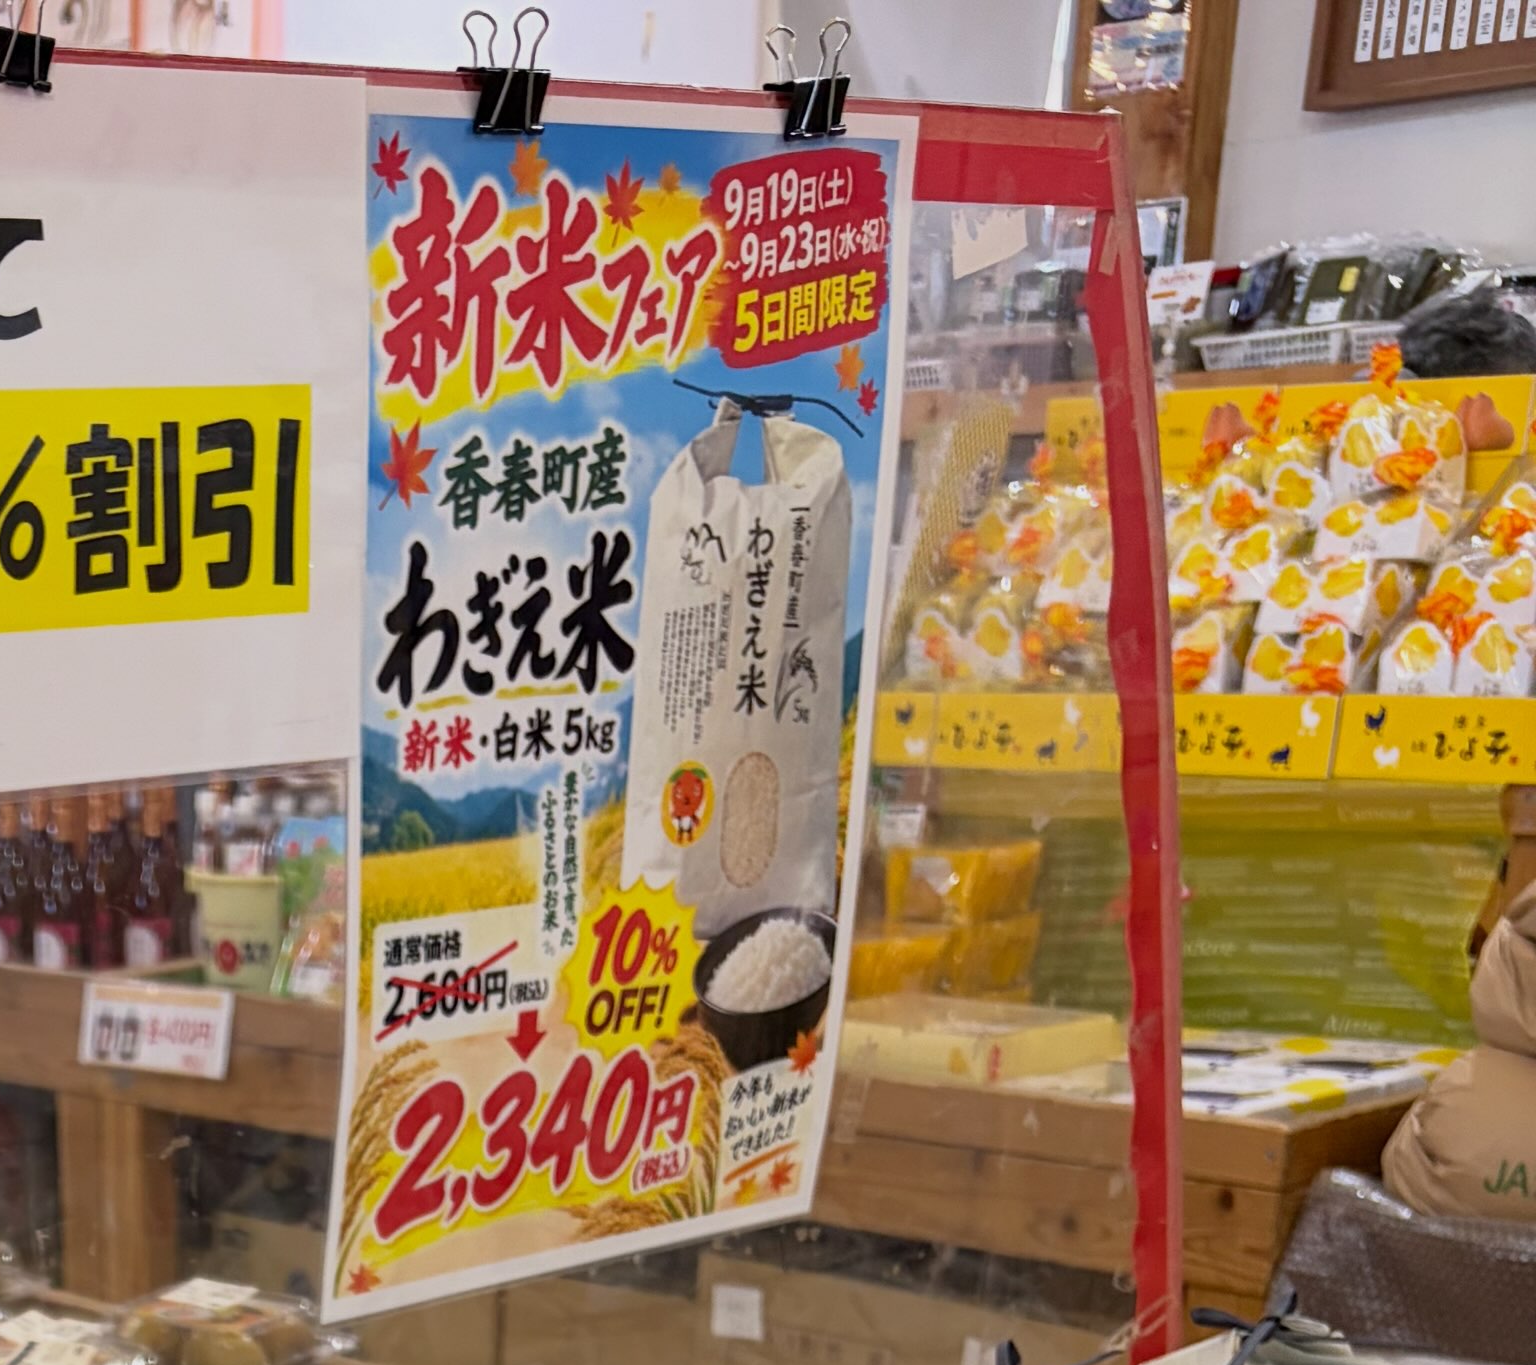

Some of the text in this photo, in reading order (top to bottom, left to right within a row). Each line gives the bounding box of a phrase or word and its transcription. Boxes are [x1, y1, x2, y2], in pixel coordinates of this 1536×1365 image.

[383, 166, 718, 400] 新米フェア
[734, 270, 877, 353] 5日間限定
[438, 427, 629, 530] 香春町産
[376, 531, 634, 710] わぎえ米
[734, 517, 775, 716] わぎえ米
[383, 928, 461, 967] 通常価格
[588, 904, 678, 985] 10%
[585, 981, 671, 1036] OFF!
